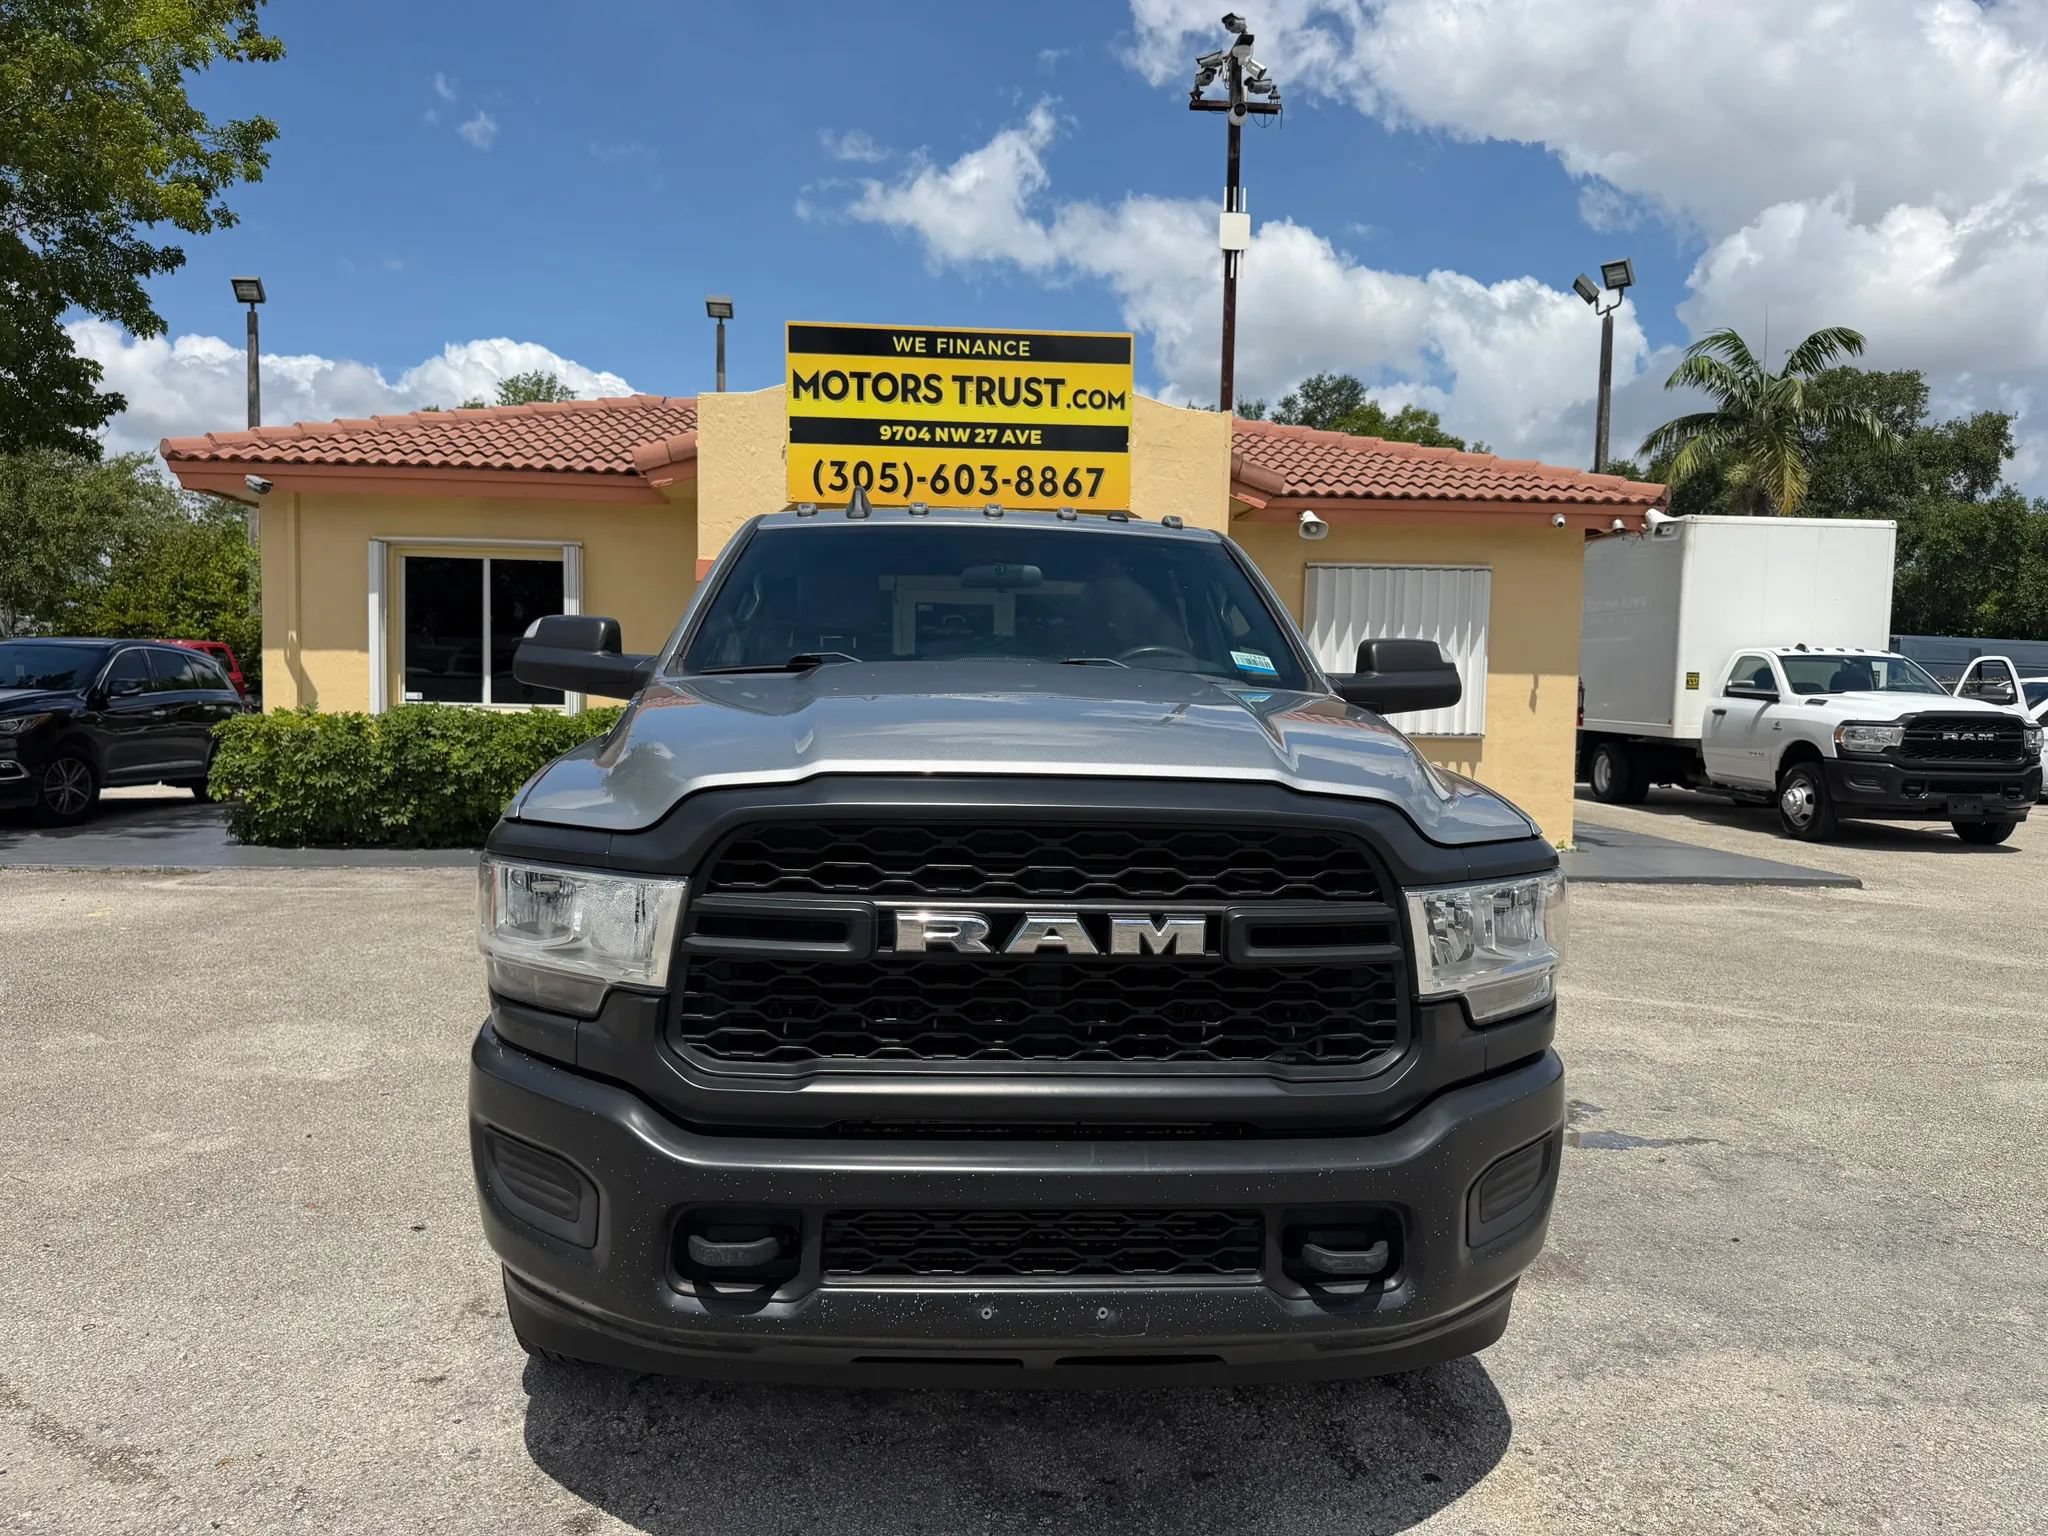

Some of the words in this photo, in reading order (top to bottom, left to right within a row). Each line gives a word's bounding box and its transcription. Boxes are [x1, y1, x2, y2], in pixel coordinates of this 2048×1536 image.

[893, 336, 927, 353] WE
[936, 337, 1031, 357] FINANCE
[792, 368, 943, 405] MOTORS
[952, 374, 1126, 411] TRUST.COM
[879, 425, 931, 442] 9704
[935, 427, 971, 444] NW
[974, 428, 998, 444] 27
[1001, 429, 1042, 445] AVE
[813, 459, 1105, 498] (305)-603-8867
[1943, 732, 1994, 741] RAM
[896, 909, 1206, 955] RAM
